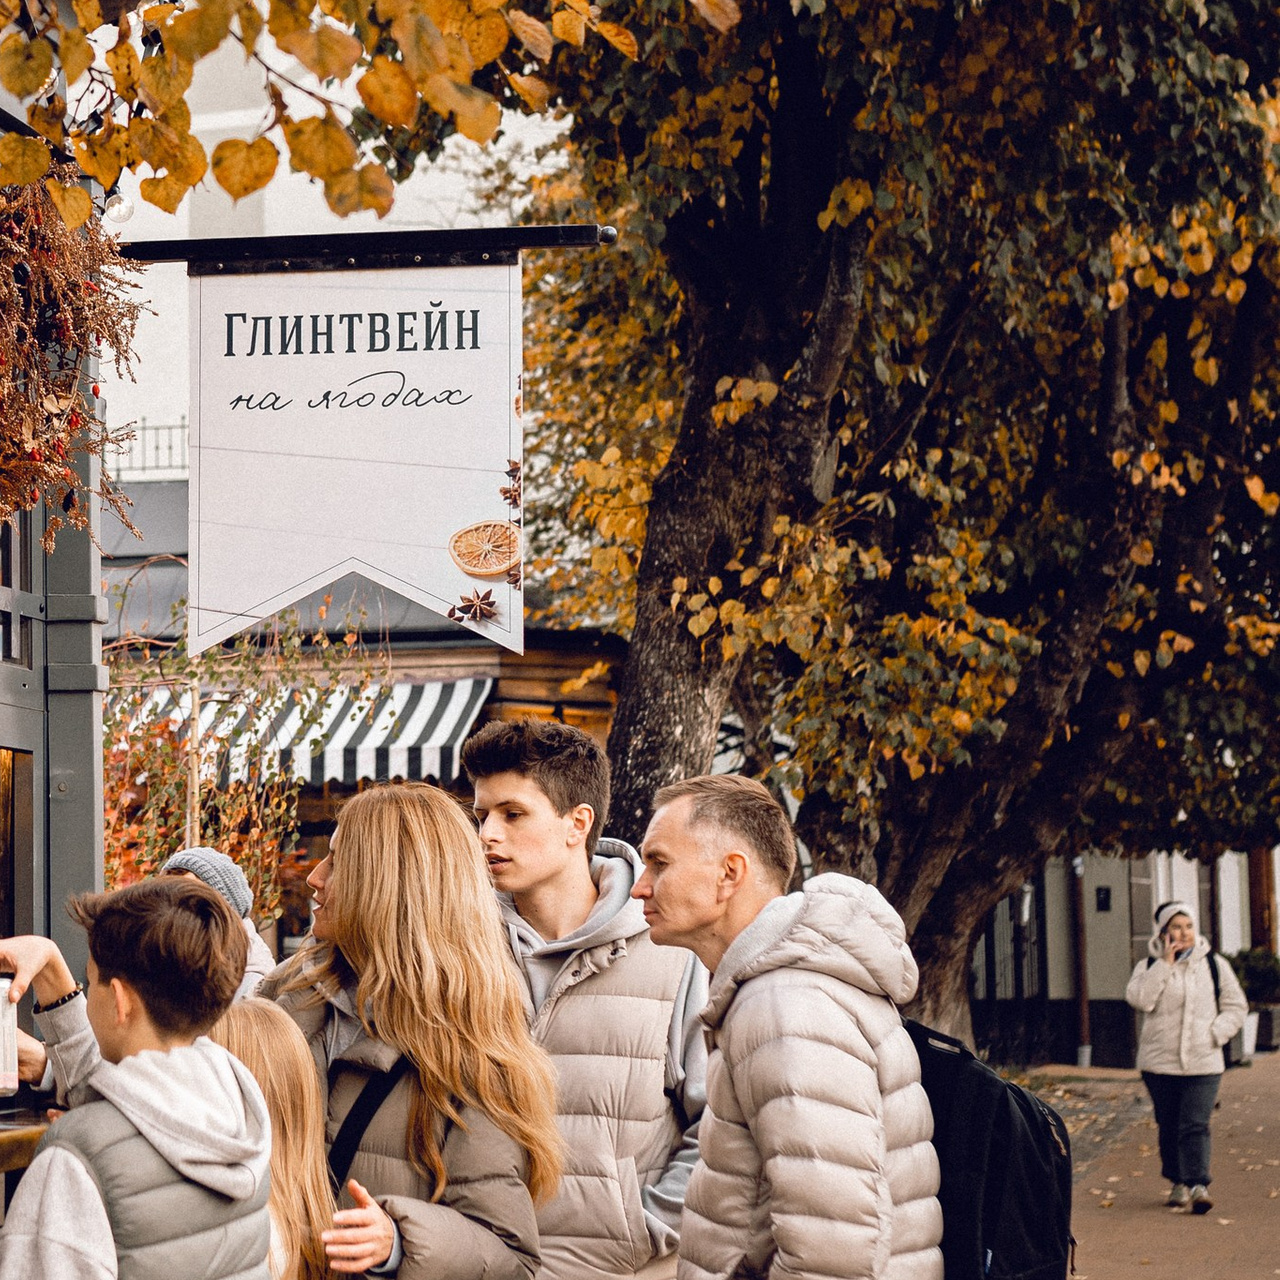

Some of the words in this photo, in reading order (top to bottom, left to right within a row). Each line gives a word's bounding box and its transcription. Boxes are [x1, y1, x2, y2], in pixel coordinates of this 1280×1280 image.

[224, 300, 481, 357] ГЛИНТВЕЙН
[230, 392, 293, 411] на
[308, 370, 473, 410] ягодах
